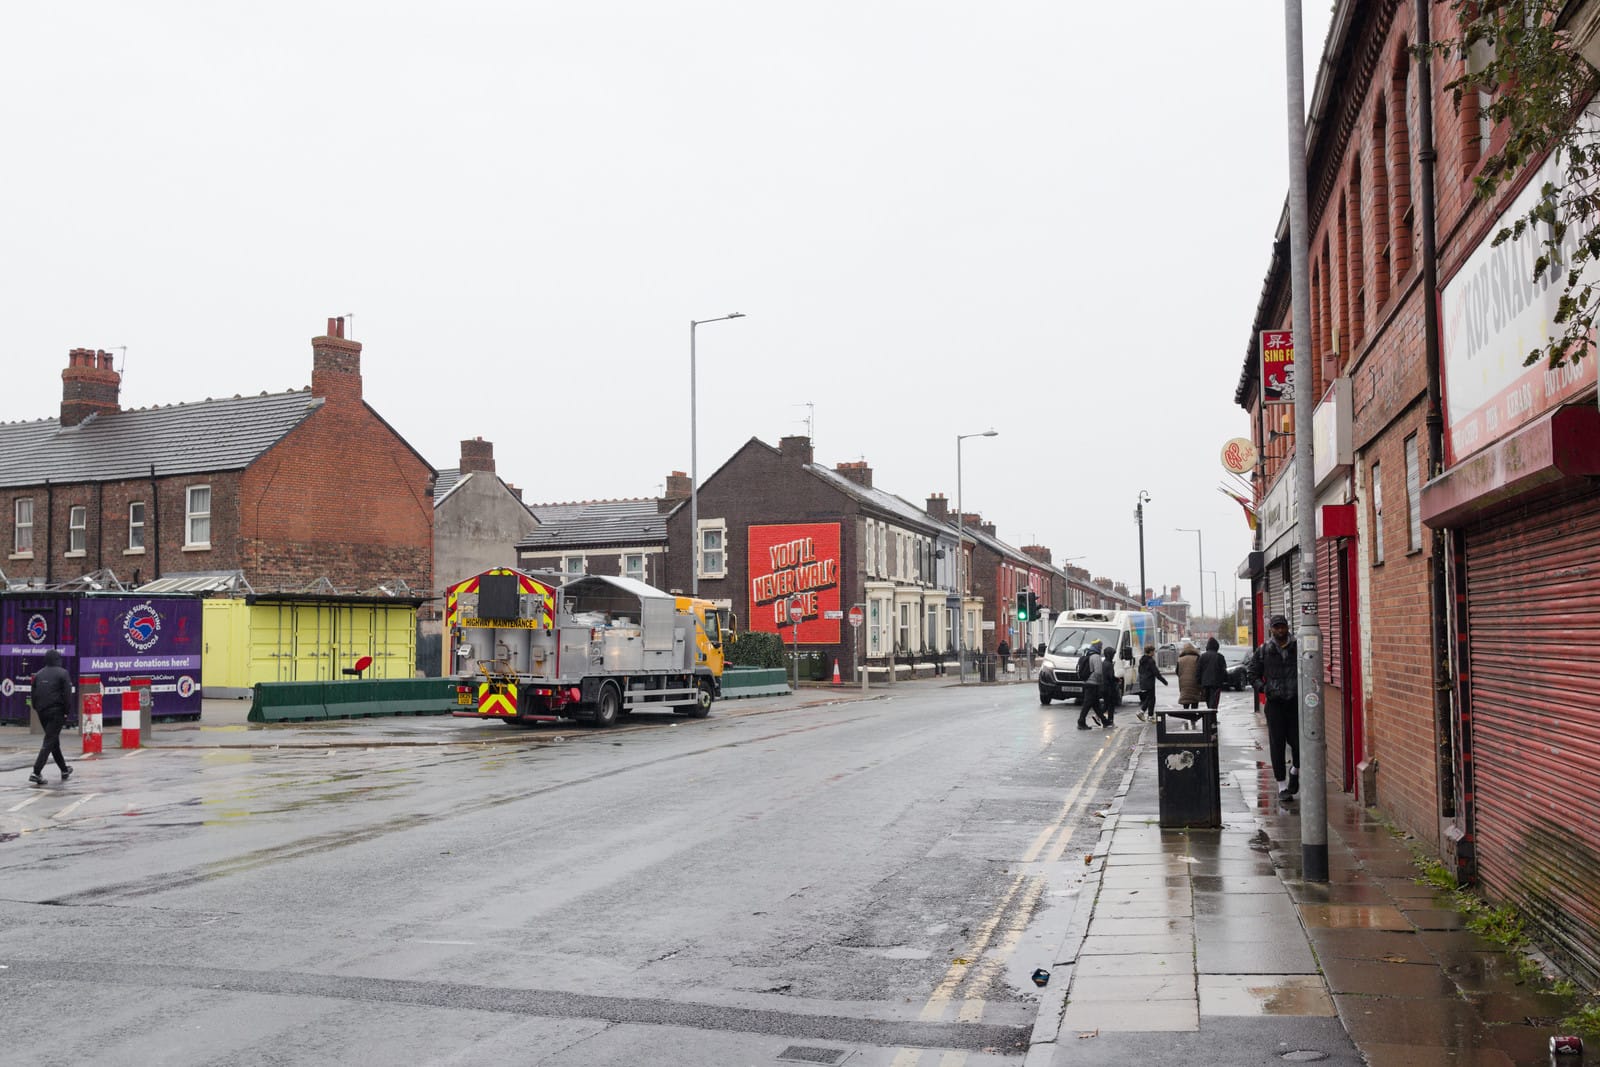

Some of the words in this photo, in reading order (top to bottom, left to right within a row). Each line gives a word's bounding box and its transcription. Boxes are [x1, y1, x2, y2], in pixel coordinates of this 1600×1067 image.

[1465, 265, 1489, 360] KOP
[1264, 350, 1284, 362] SING
[769, 537, 816, 570] YOU'LL
[753, 569, 795, 602] NEVER
[795, 559, 836, 591] WALK
[123, 610, 134, 629] FANS
[132, 604, 161, 630] SUPPORTING
[774, 592, 818, 623] ANE
[465, 618, 489, 627] HIGHWAY
[492, 618, 534, 628] MAINTENANCE
[124, 633, 159, 650] FOODBANKS
[92, 660, 113, 669] Make
[115, 660, 132, 671] your
[133, 658, 170, 668] donations
[171, 657, 190, 666] here!
